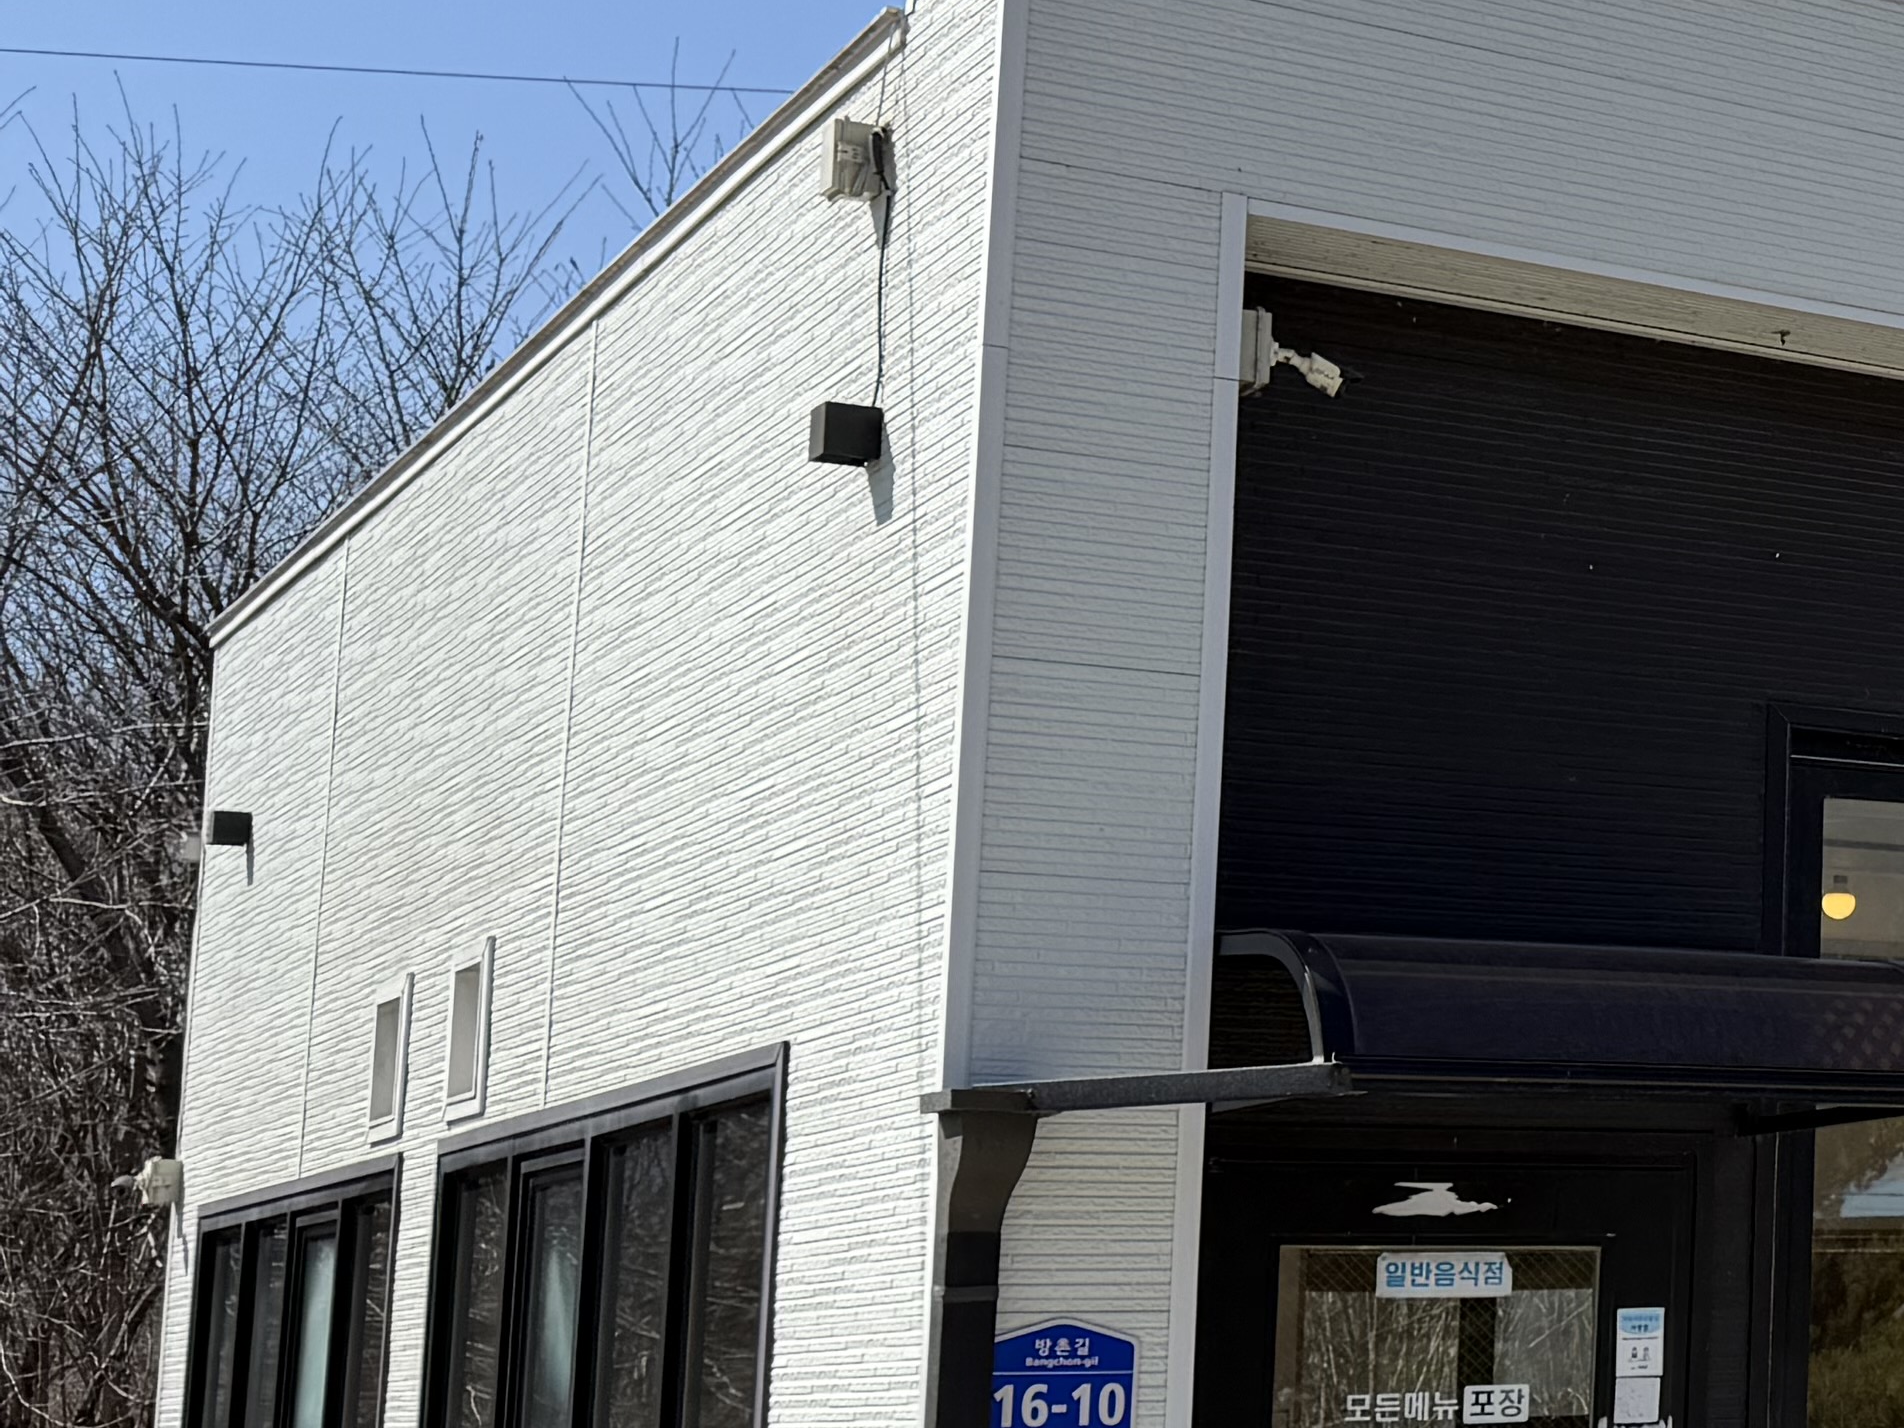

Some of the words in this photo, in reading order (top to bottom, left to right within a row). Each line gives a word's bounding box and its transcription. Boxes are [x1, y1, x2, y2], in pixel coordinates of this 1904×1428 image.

[1384, 1260, 1504, 1289] 일반음식점
[1025, 1356, 1100, 1369] Bangchon-gil
[992, 1382, 1126, 1428] 16-10
[1344, 1391, 1460, 1422] 모든메뉴
[1469, 1387, 1526, 1418] 포장
